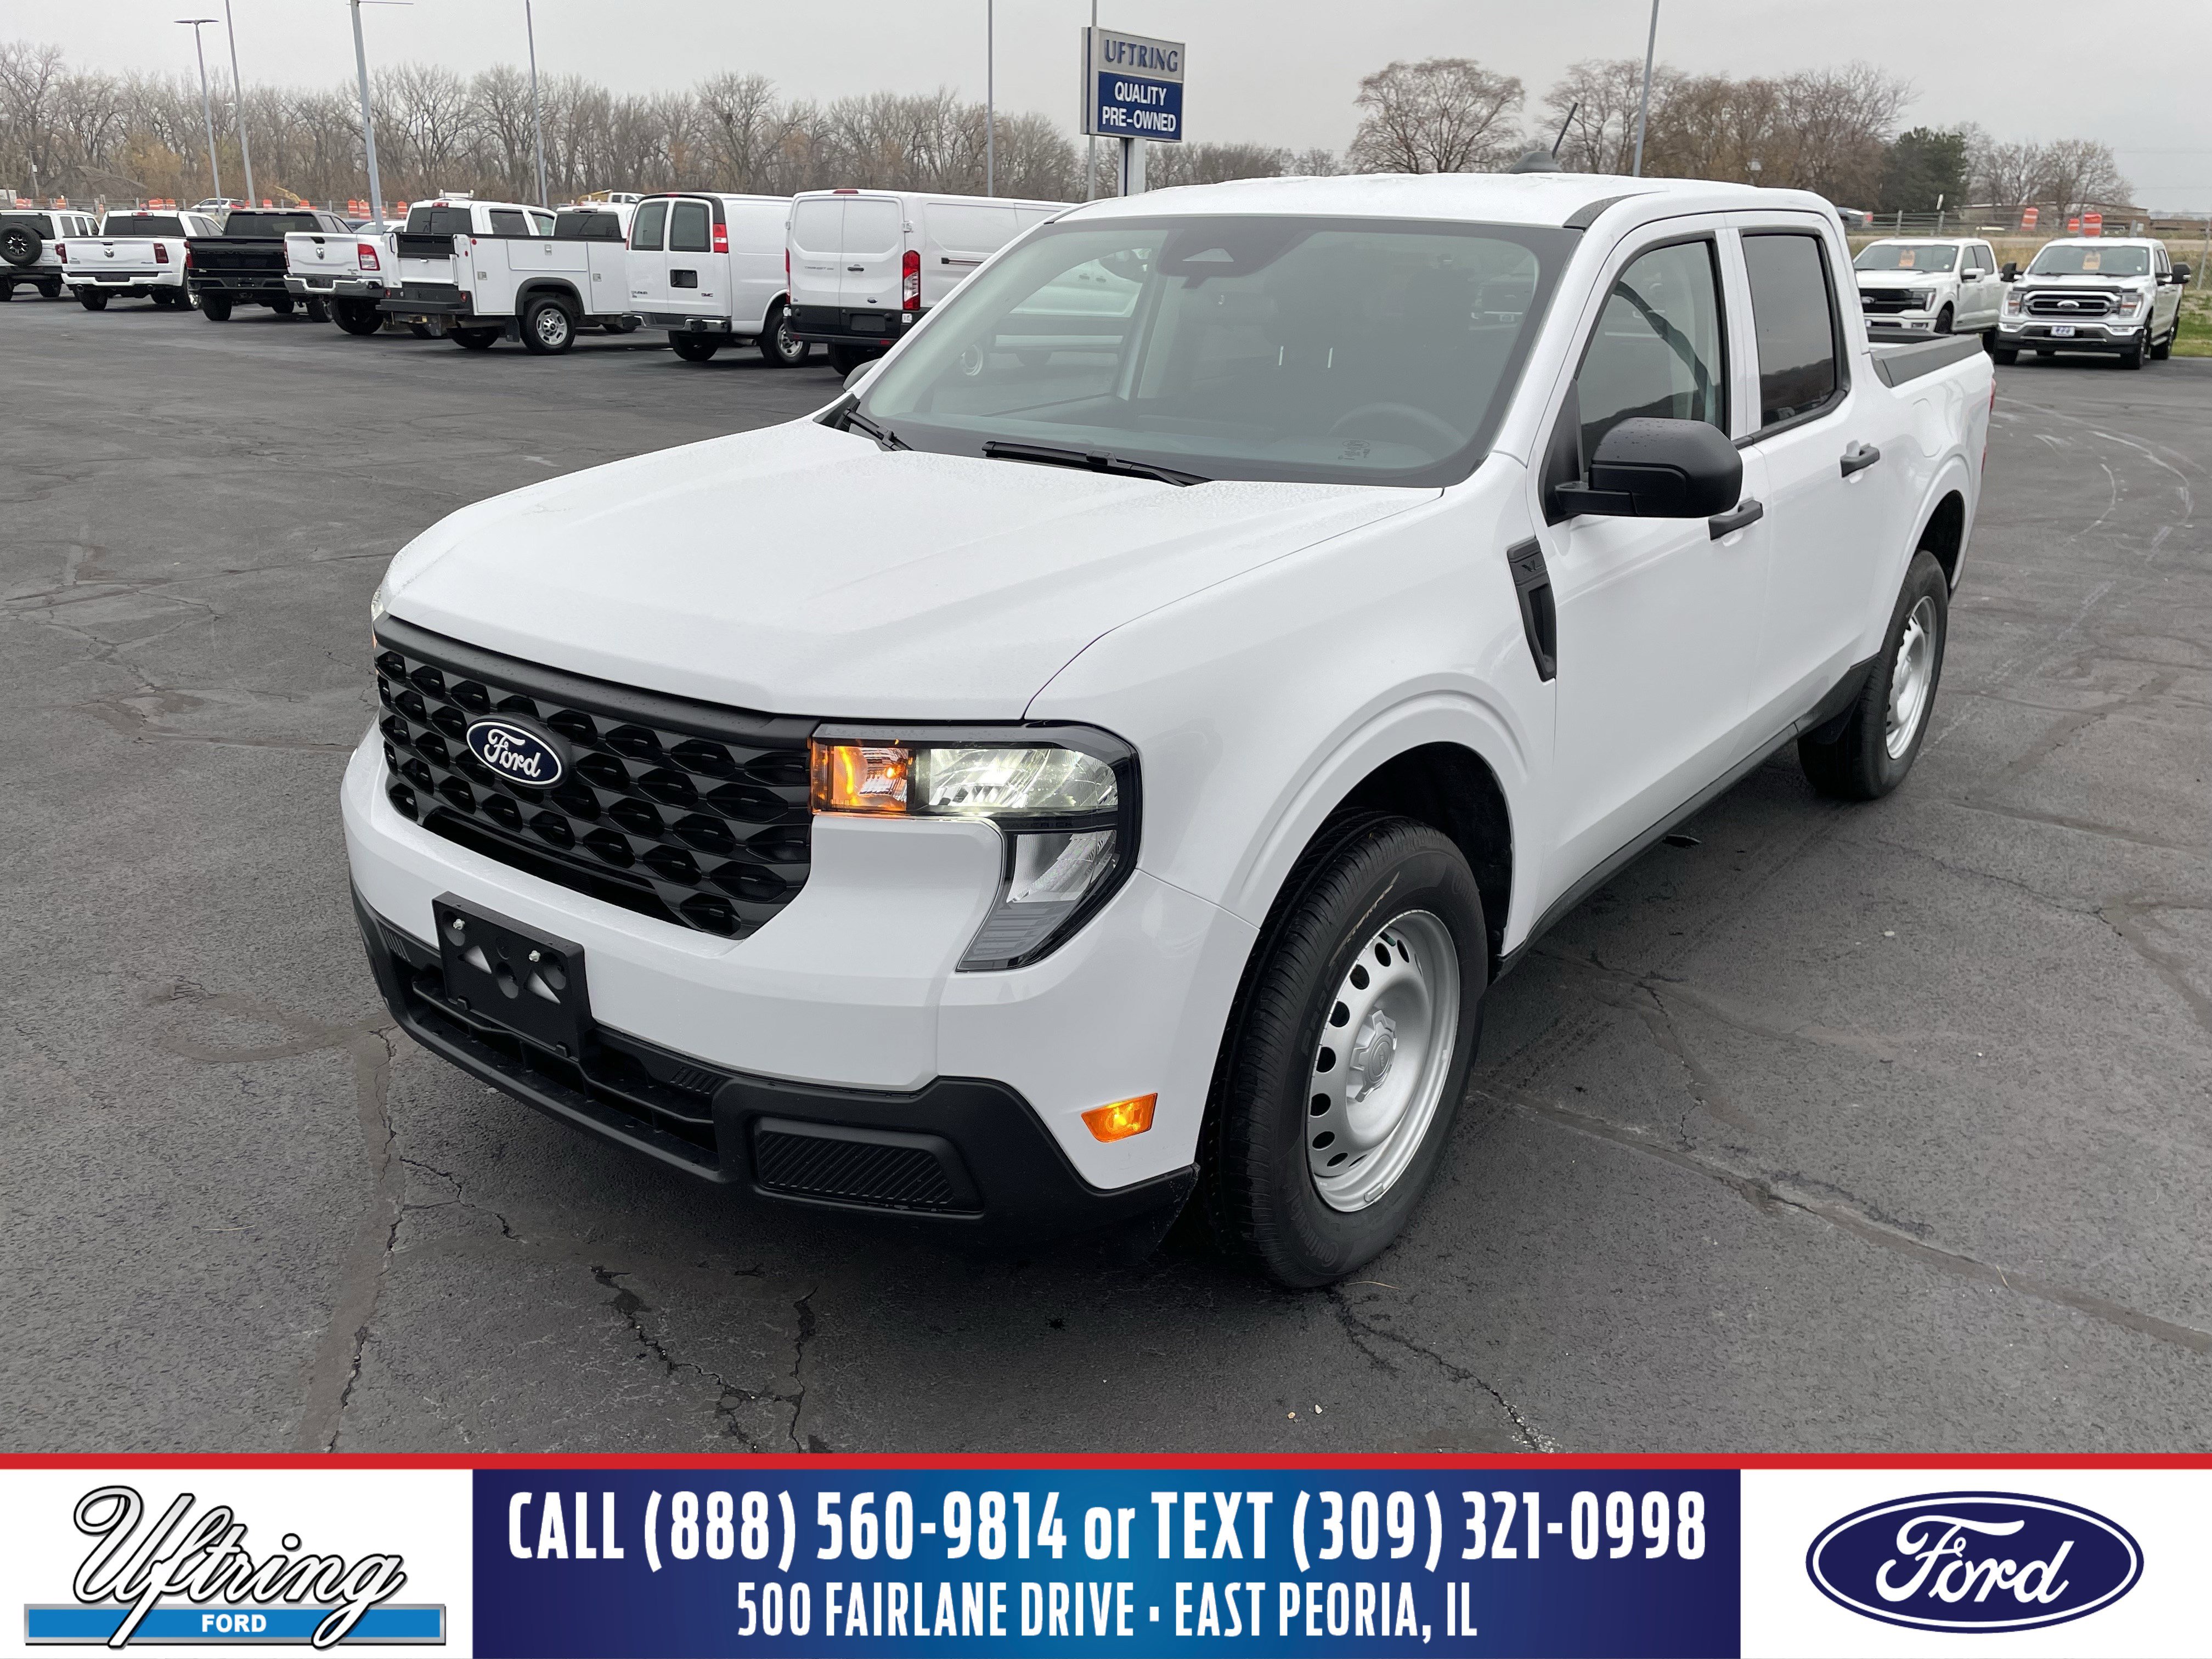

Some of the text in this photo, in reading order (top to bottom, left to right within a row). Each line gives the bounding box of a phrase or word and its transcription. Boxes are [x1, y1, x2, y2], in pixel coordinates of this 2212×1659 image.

[1104, 39, 1178, 72] UFTRING
[1114, 81, 1167, 106] QUALITY
[1102, 105, 1177, 132] PRE-OWNED
[483, 729, 541, 777] Ford
